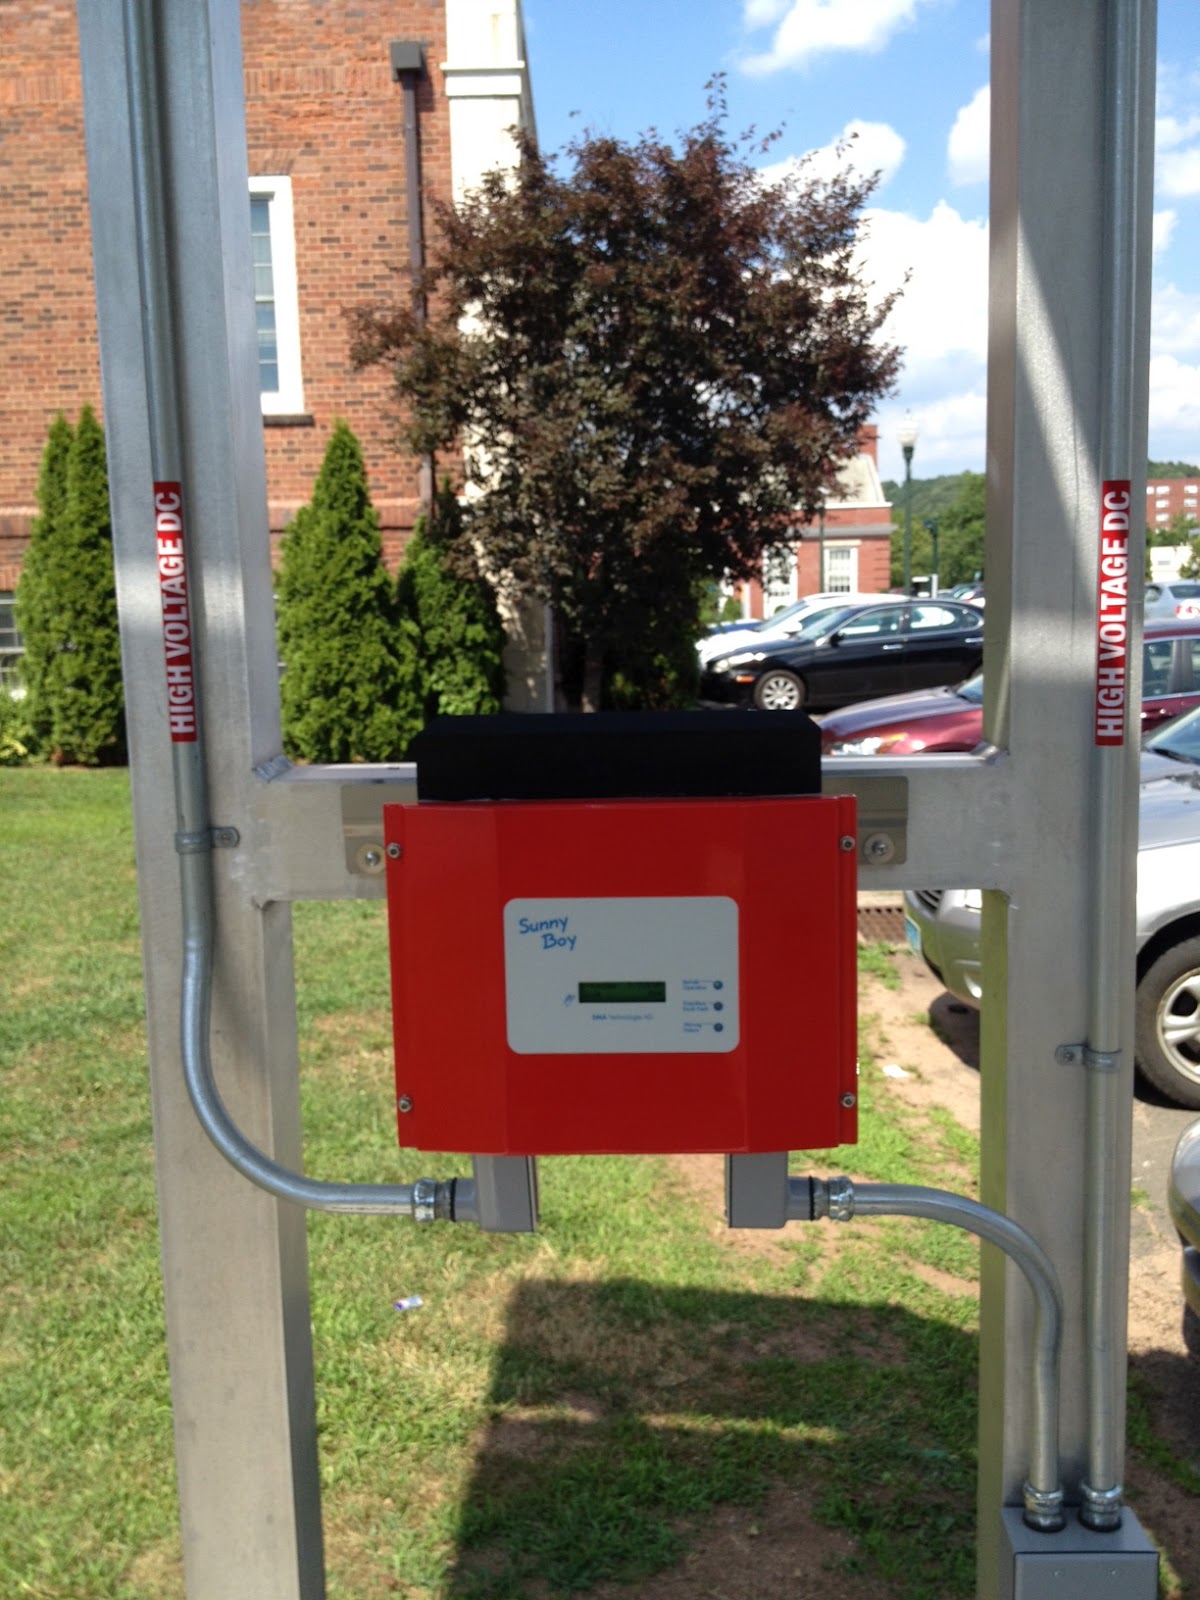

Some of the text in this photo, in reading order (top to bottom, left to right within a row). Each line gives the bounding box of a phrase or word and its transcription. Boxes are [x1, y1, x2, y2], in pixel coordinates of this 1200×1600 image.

[155, 492, 195, 733] HIGH VOLTAGE DC
[1097, 491, 1130, 736] HIGH VOLTAGE DC
[518, 917, 568, 934] Sunny
[541, 932, 577, 951] Boy
